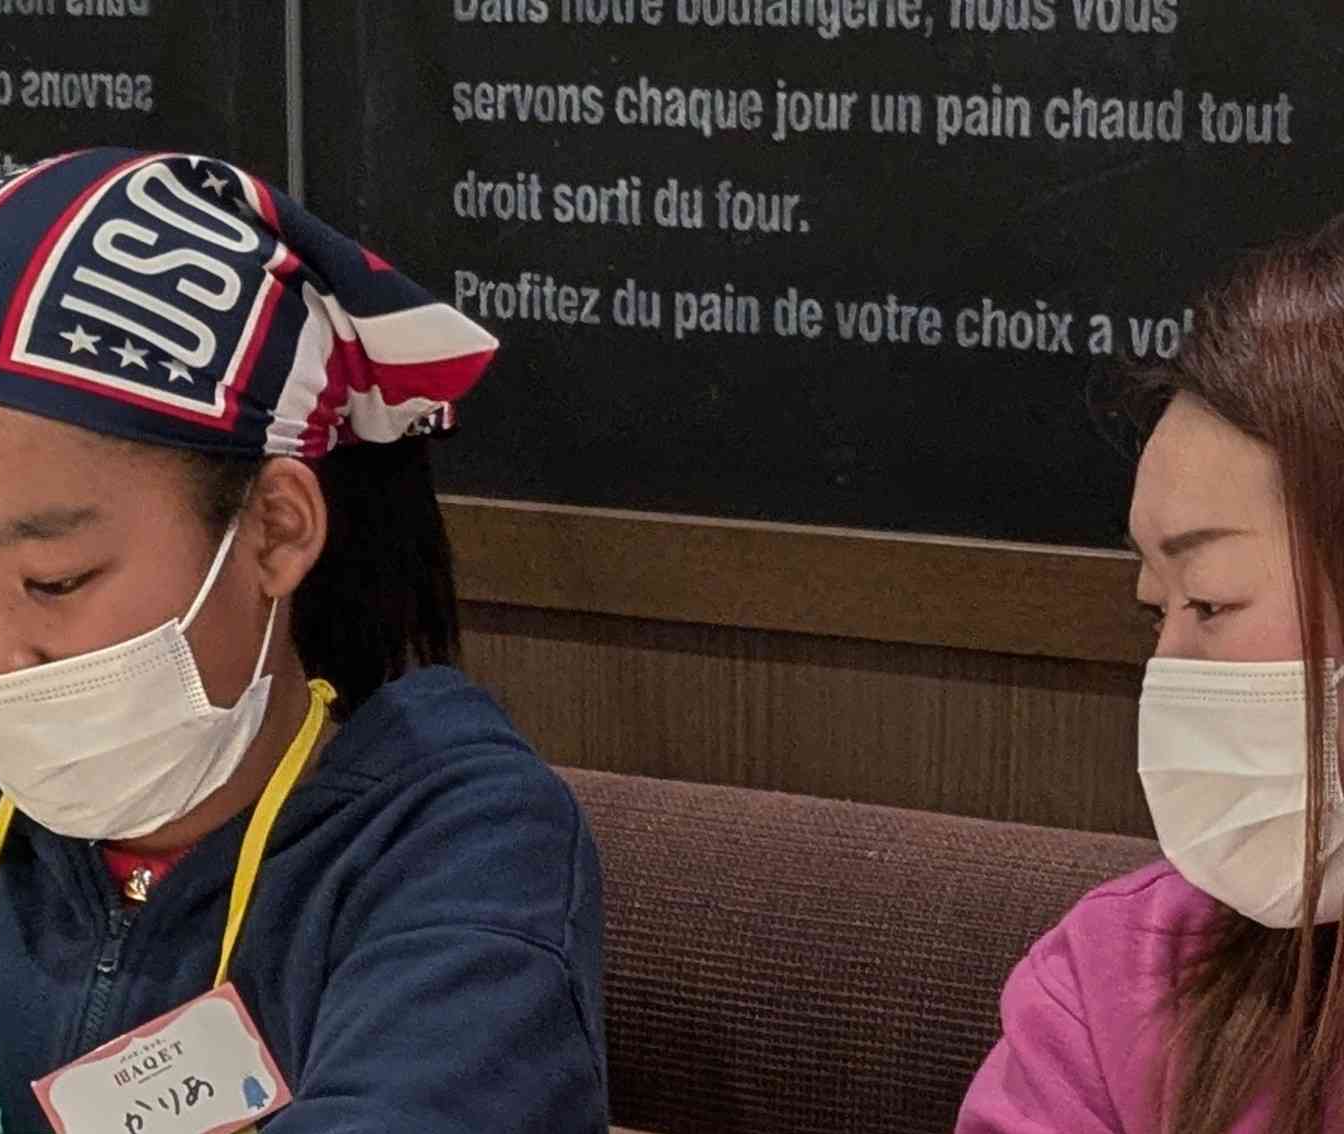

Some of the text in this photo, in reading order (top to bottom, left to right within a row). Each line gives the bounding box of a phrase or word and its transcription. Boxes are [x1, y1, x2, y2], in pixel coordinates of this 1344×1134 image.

[950, 0, 1054, 32] nous
[1073, 0, 1177, 32] vous
[453, 76, 1293, 145] servons chaque jour un pain chaud tout
[454, 170, 810, 232] droit sorti du four.
[60, 161, 260, 369] USO
[454, 270, 600, 325] Profitez
[613, 279, 661, 327] du
[675, 283, 759, 340] pain
[774, 287, 823, 339] de
[836, 294, 943, 345] votre
[957, 298, 1074, 354] choix
[1088, 313, 1113, 354] a
